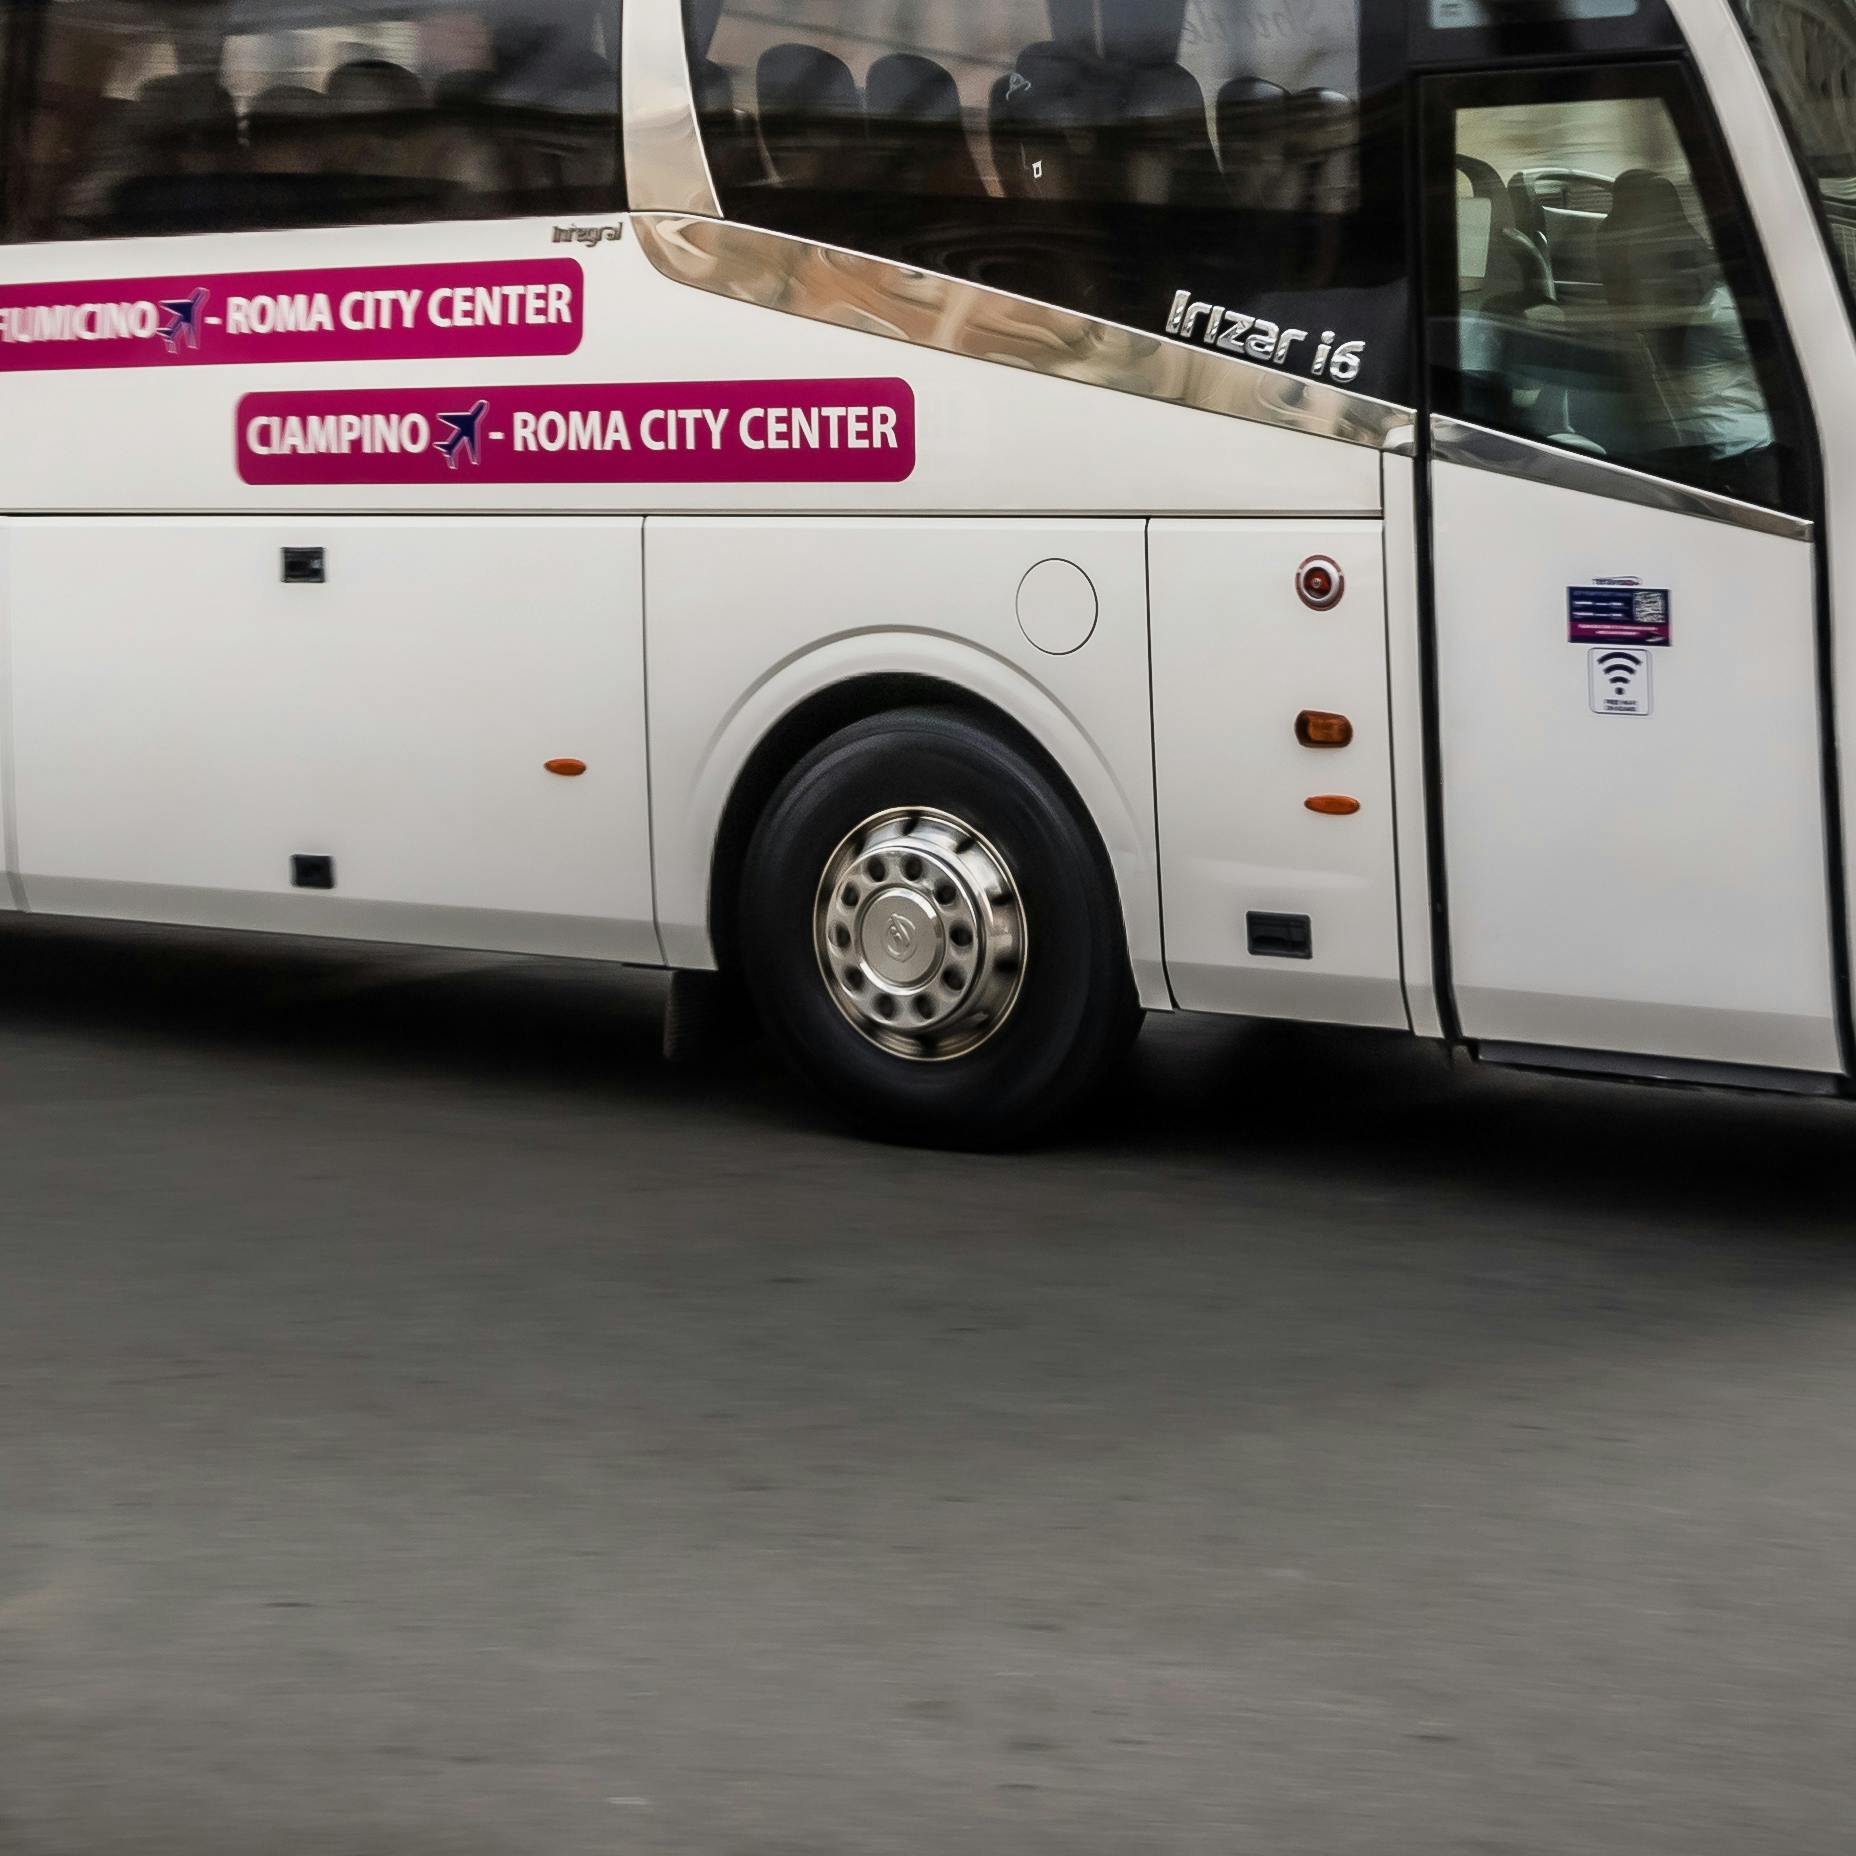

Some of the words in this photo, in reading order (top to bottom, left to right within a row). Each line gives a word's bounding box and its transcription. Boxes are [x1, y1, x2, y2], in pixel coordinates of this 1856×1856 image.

[226, 290, 334, 334] ROMA
[339, 288, 422, 331] CITY
[426, 283, 574, 329] CENTER
[1165, 289, 1308, 365] Irizar
[1311, 330, 1366, 383] i6
[246, 411, 431, 456] CIAMPINO
[511, 408, 632, 453] ROMA
[638, 407, 730, 452] CITY
[738, 404, 899, 450] CENTER
